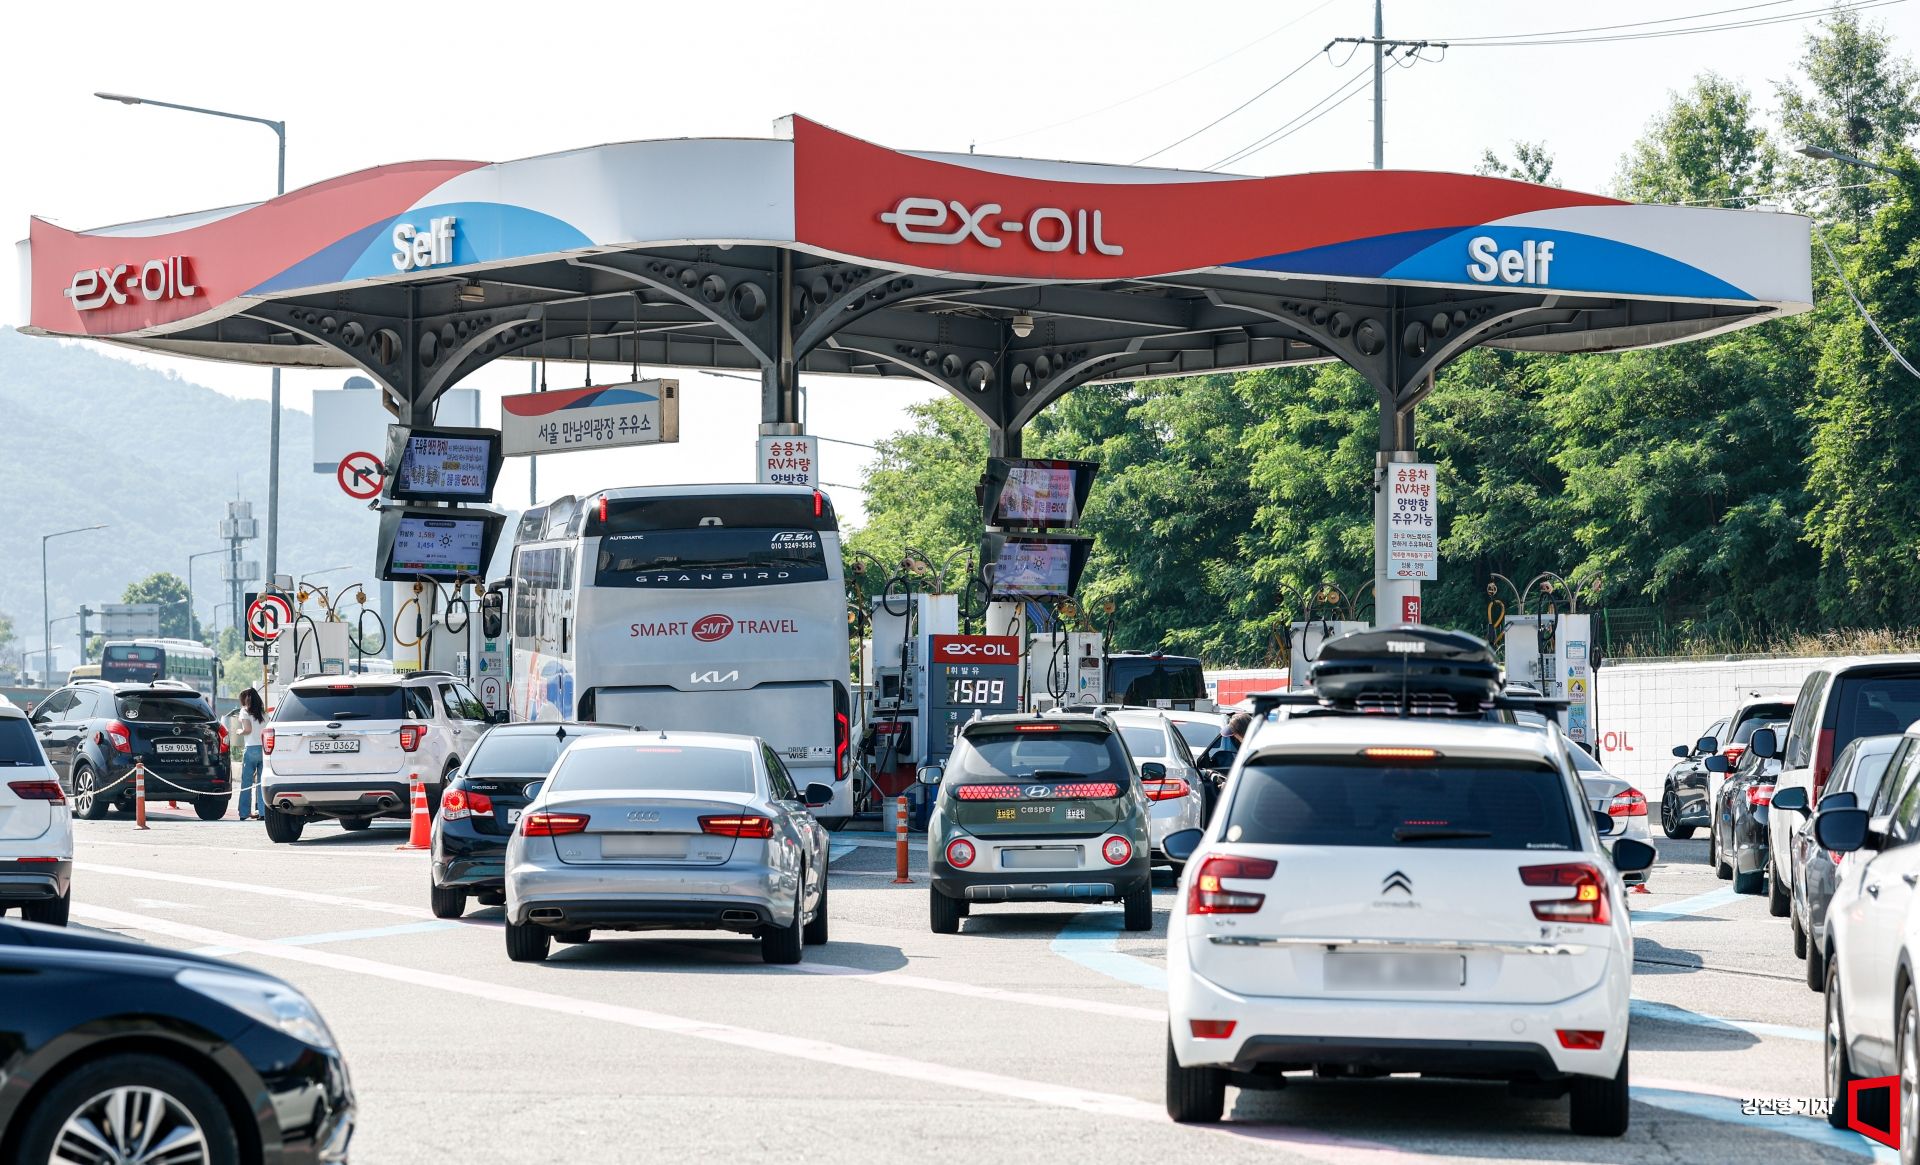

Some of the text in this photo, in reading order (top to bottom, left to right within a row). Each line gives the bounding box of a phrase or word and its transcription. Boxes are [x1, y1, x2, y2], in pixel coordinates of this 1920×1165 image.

[880, 197, 1124, 256] ex-OIL
[392, 216, 456, 270] Self
[1467, 236, 1555, 285] Self
[538, 414, 652, 445] 서울 만남의광장 주유소
[770, 441, 807, 457] 승용차
[768, 458, 811, 472] RV차량
[1397, 468, 1428, 482] 승용차
[1395, 483, 1431, 497] RV차량
[1397, 497, 1429, 512] 양방향
[1391, 512, 1434, 527] 주유가능
[771, 541, 817, 550] 010 3249-3535
[636, 571, 789, 583] GRANBIRD
[630, 619, 799, 638] SMART SMT TRAVEL
[942, 643, 1011, 656] ex-OIL
[1386, 640, 1426, 653] THULE
[953, 679, 1004, 704] 1589
[333, 740, 355, 750] 0362
[1020, 805, 1055, 814] casper
